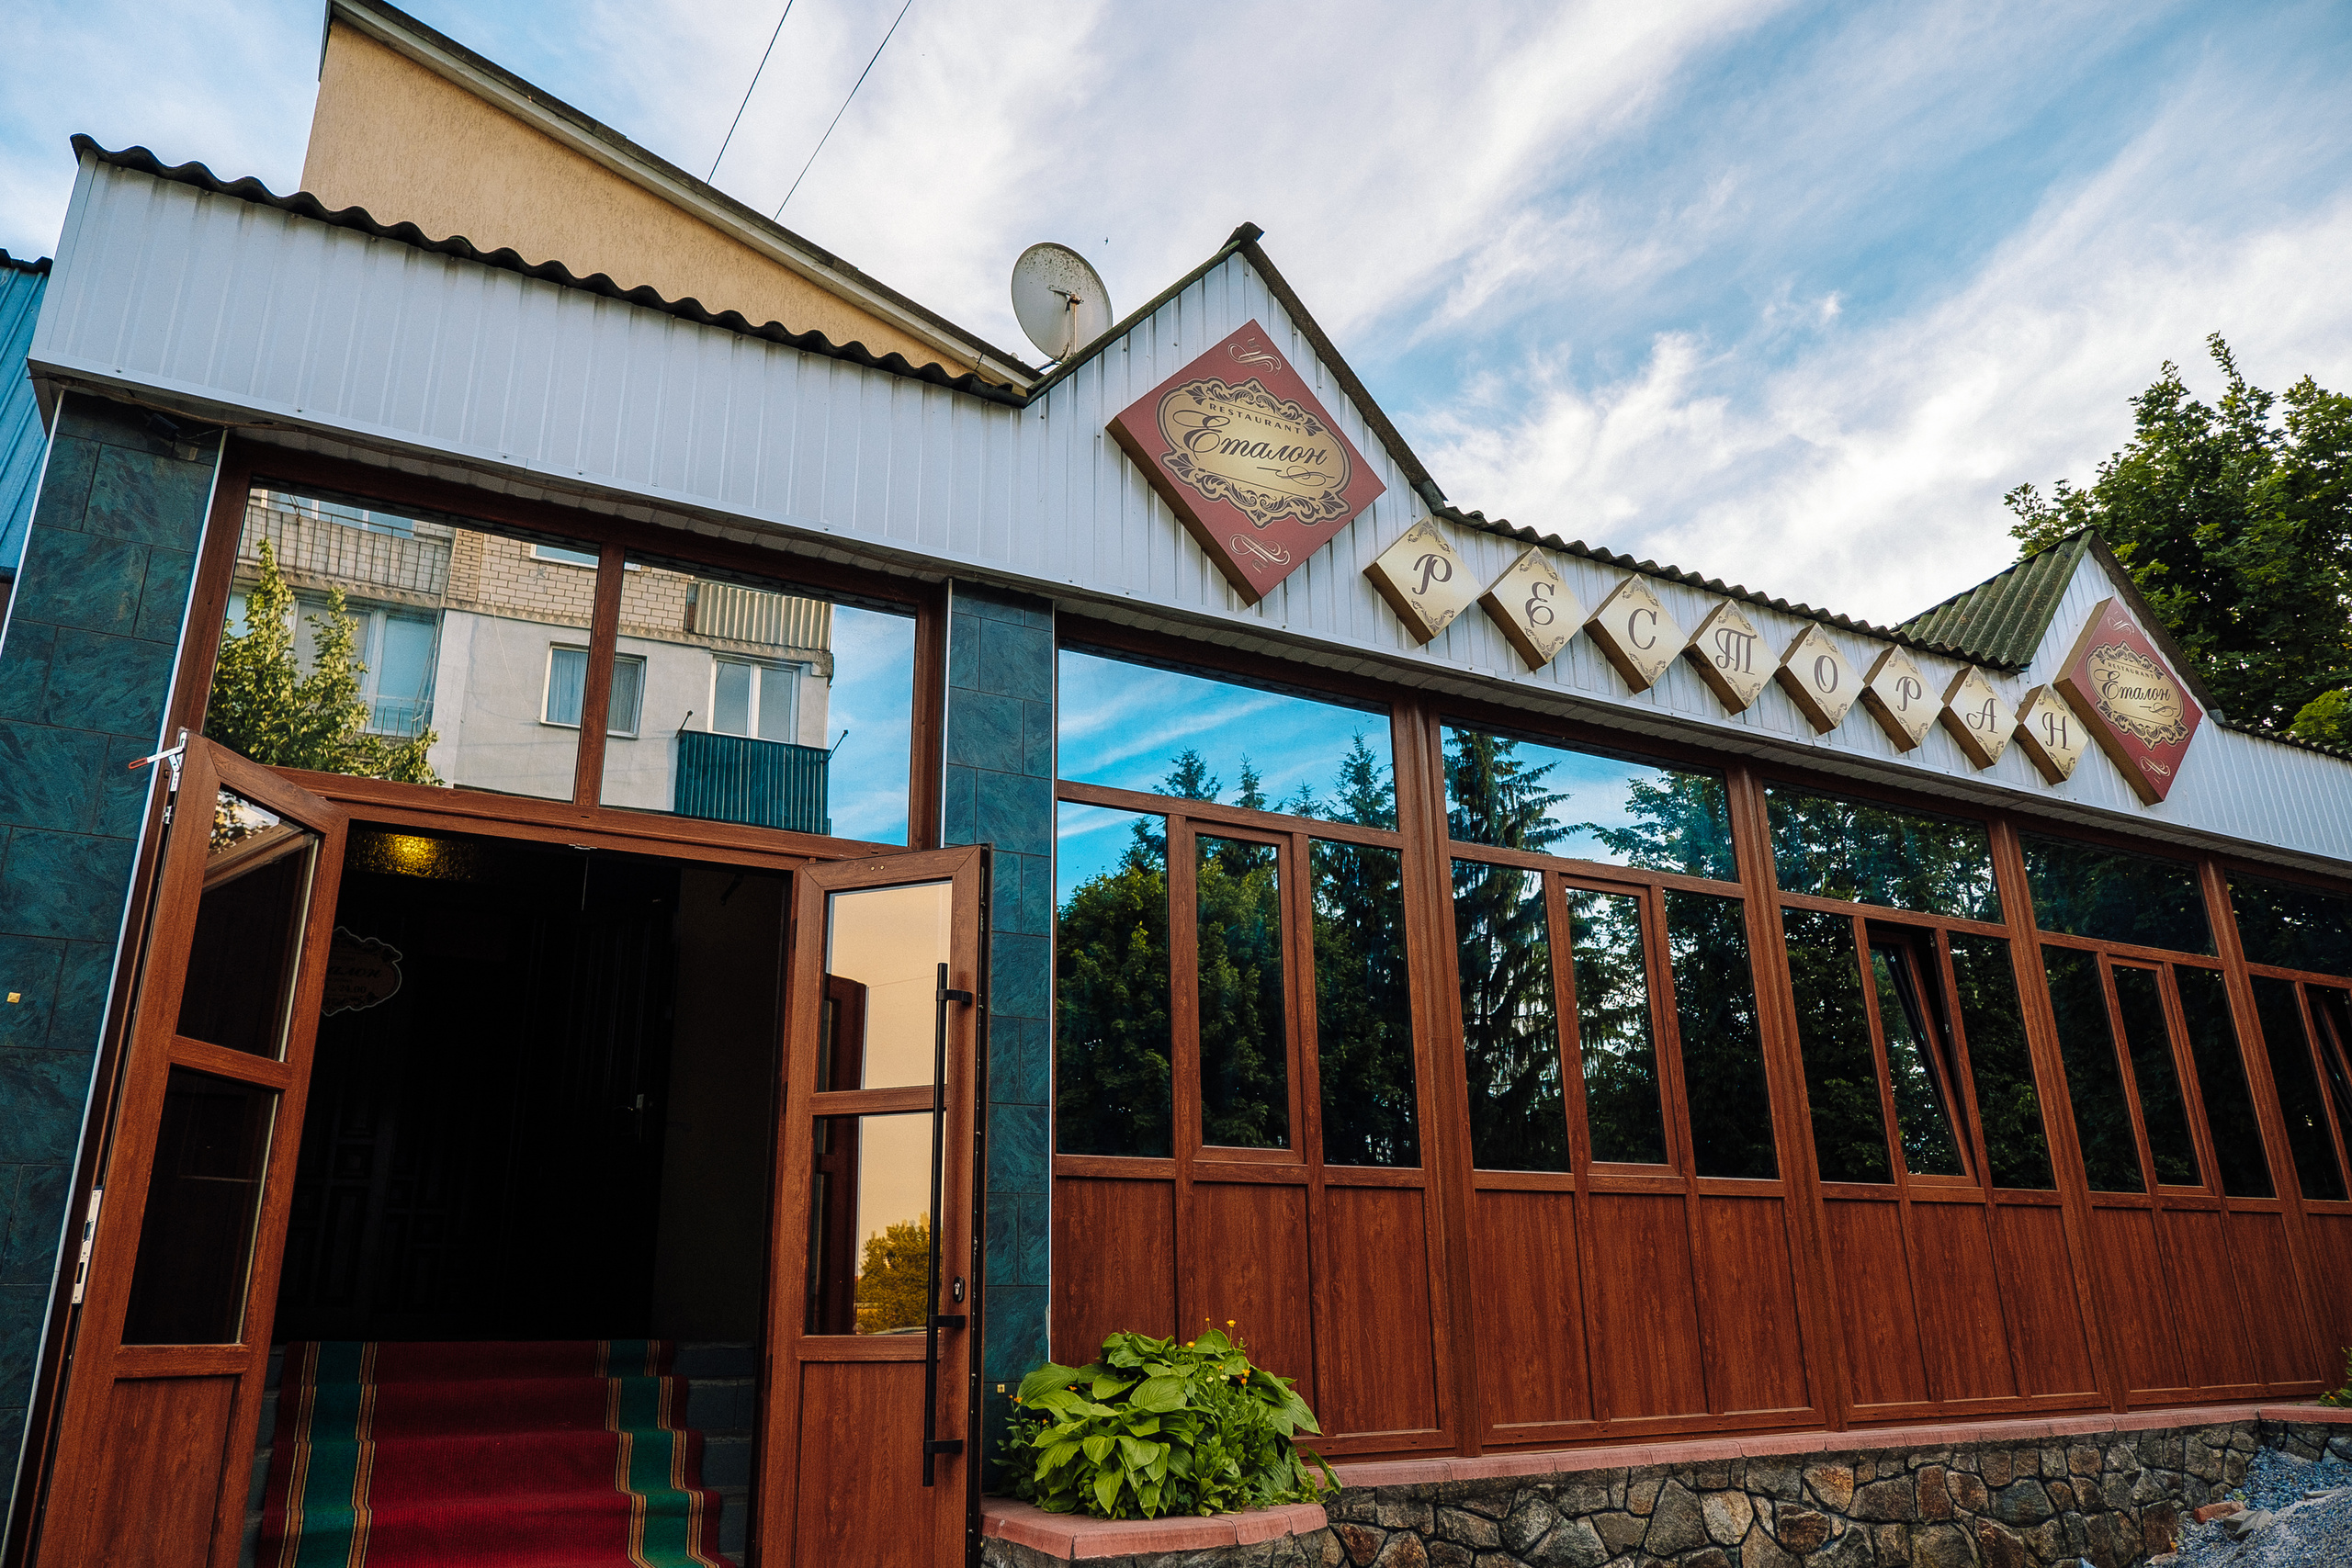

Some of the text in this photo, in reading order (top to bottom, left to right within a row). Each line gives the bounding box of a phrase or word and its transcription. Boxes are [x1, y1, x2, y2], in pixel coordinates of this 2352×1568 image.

[1209, 402, 1302, 435] RESTAURANT
[1172, 410, 1328, 466] Еталон
[1411, 553, 2067, 750] РЕСТОРАН
[2094, 669, 2171, 705] Еталон
[2108, 662, 2154, 680] RESTAURANT
